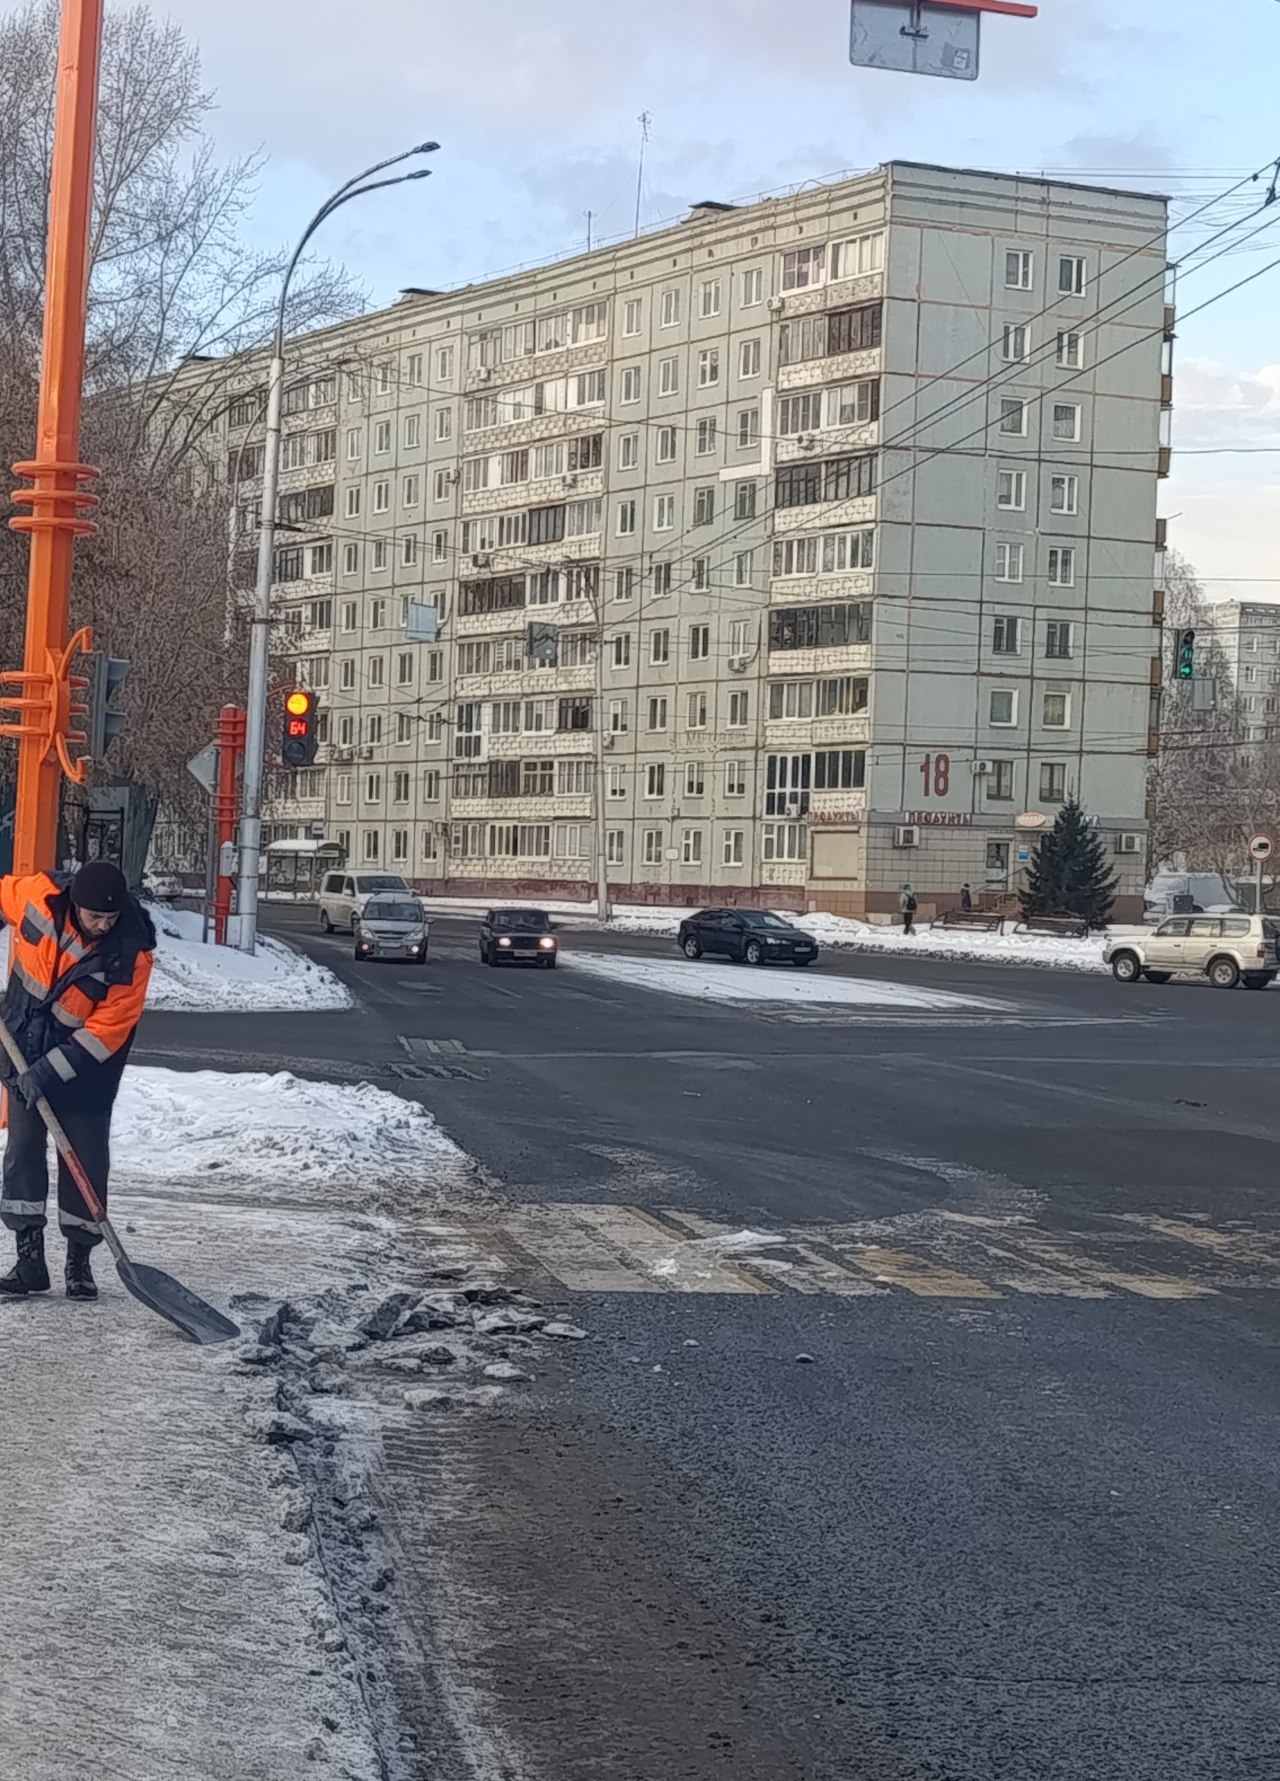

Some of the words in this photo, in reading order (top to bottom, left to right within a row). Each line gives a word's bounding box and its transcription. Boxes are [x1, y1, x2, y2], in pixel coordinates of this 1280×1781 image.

[289, 721, 306, 735] 64
[920, 753, 950, 797] 18
[807, 810, 859, 823] ПРОДУКТЫ
[908, 811, 972, 826] ПРОДУКТЫ
